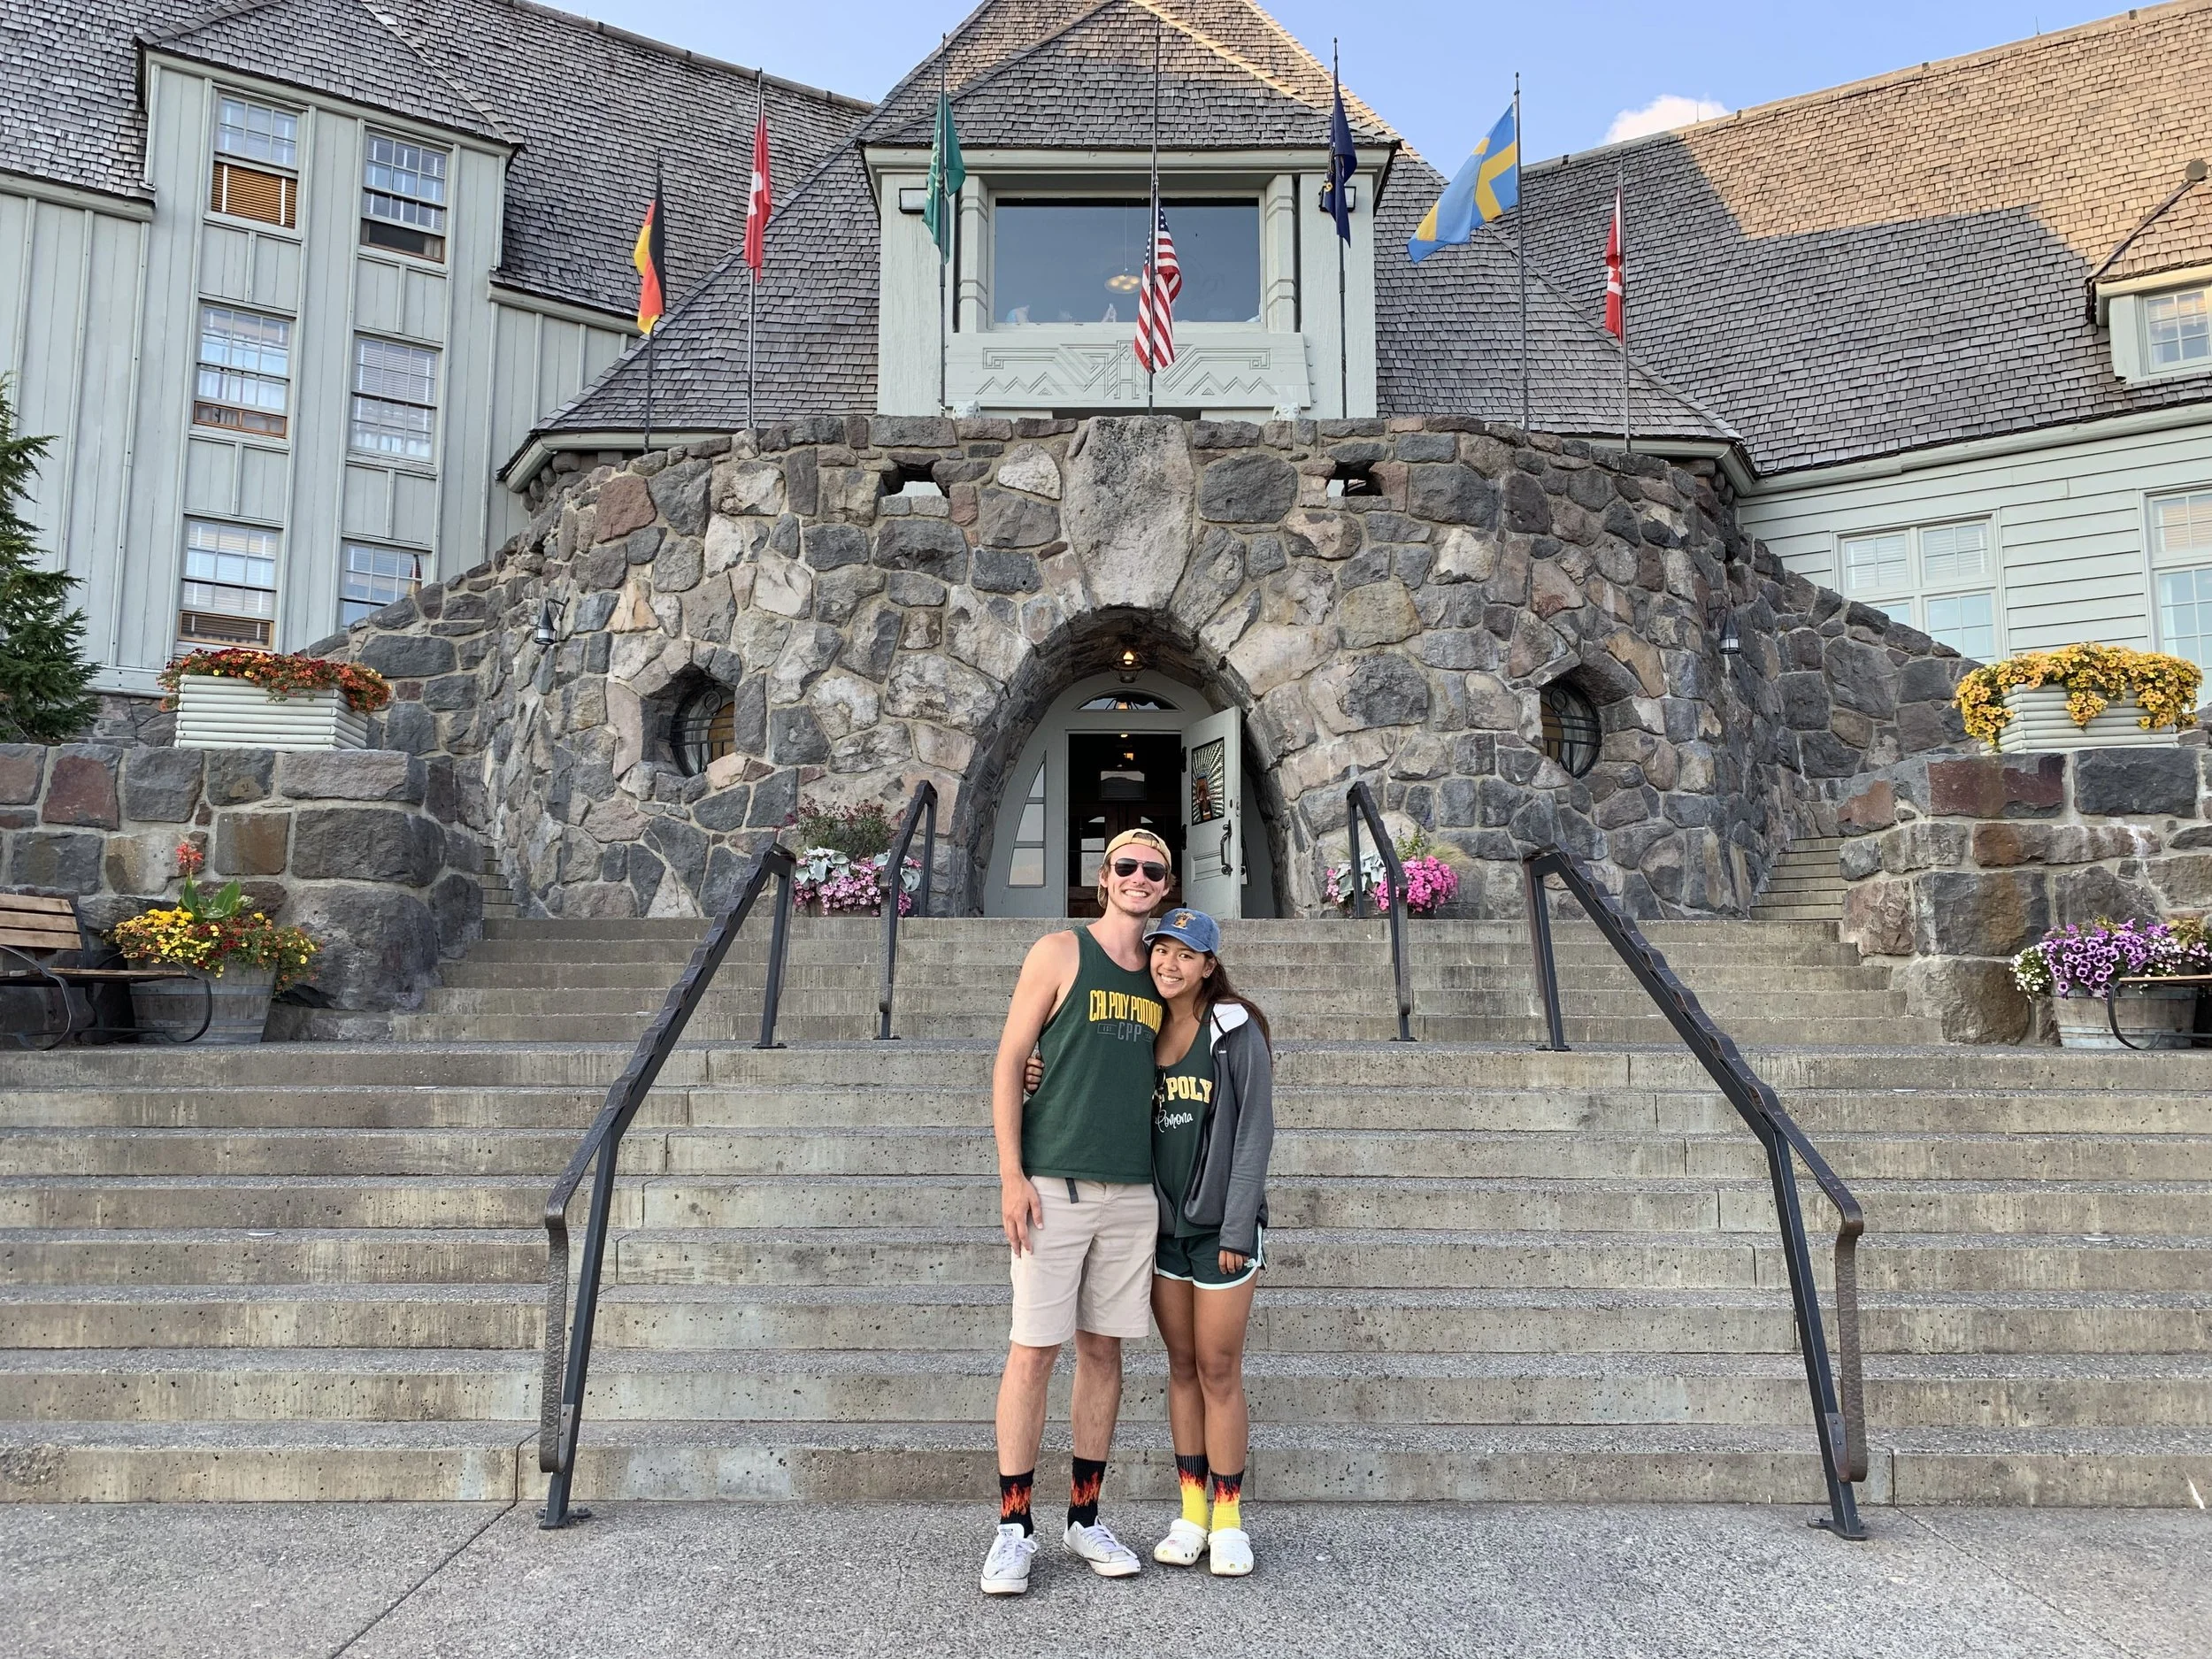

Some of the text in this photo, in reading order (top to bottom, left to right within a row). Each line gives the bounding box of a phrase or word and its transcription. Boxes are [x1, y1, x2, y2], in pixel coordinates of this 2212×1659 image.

[1089, 990, 1108, 1022] CAL
[1108, 991, 1130, 1020] POLY
[1118, 1021, 1142, 1042] CPP
[1165, 1076, 1212, 1103] POLY
[1155, 1109, 1194, 1133] Pomona
